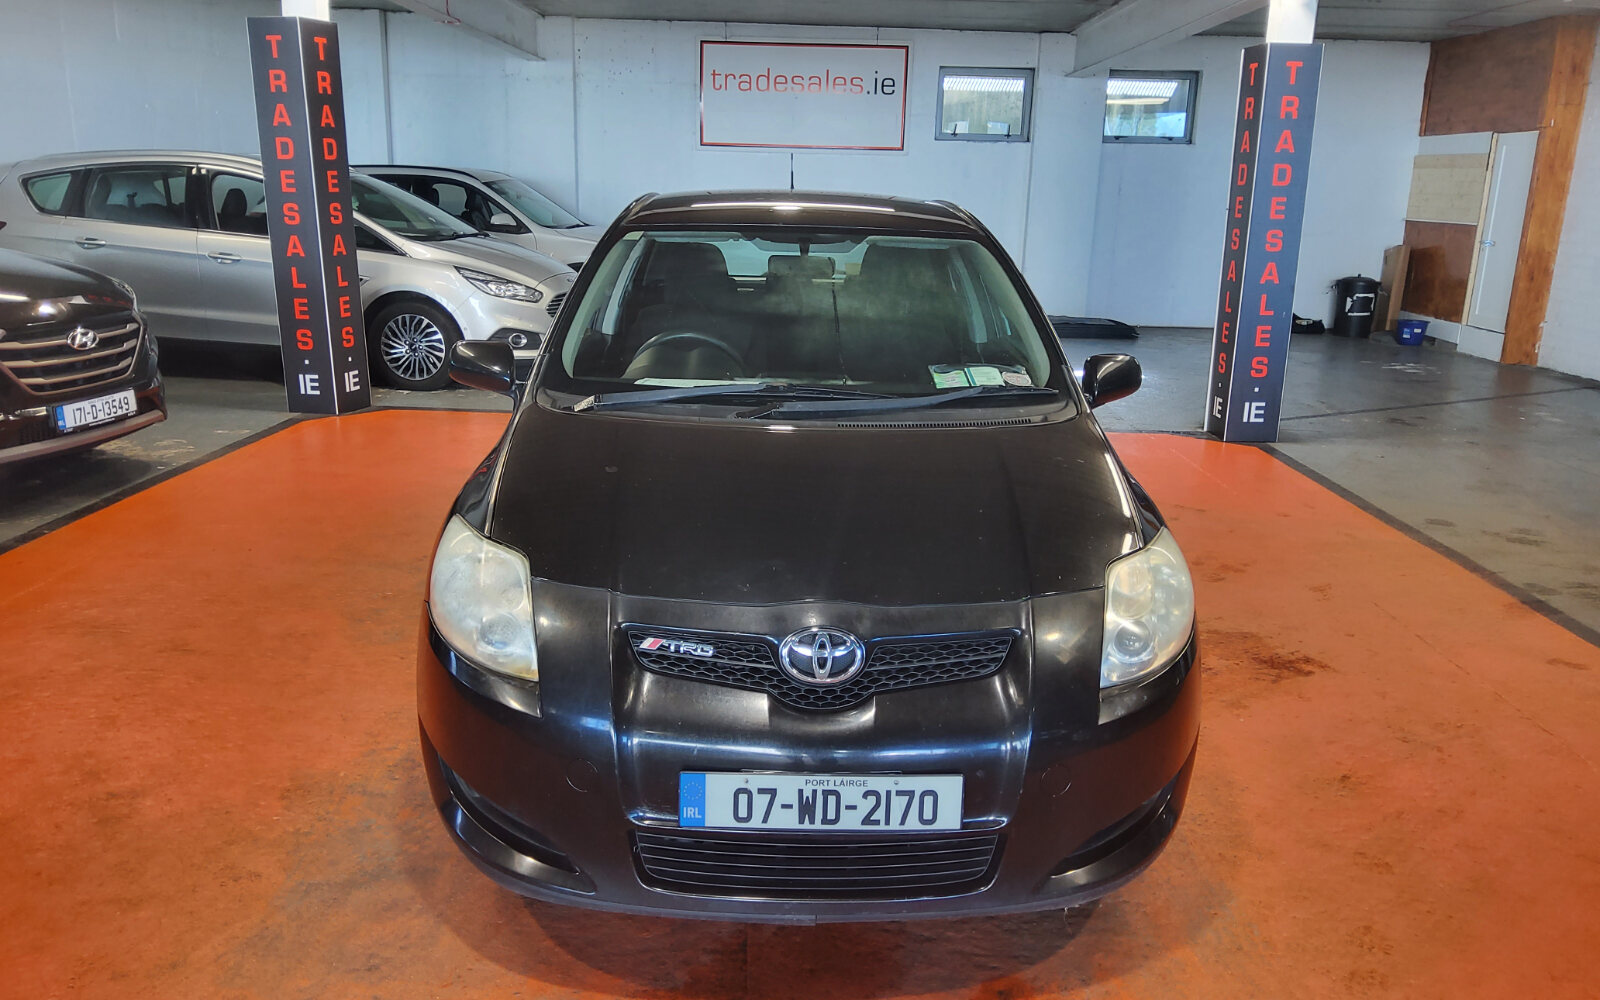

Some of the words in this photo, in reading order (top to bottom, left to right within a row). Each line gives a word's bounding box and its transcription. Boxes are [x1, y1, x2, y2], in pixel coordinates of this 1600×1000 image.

[711, 67, 896, 96] tradesales.ie
[72, 396, 130, 424] 171-D-13549
[805, 779, 831, 787] PORT
[833, 778, 869, 788] LÁIRGE
[683, 806, 702, 819] IRL
[732, 788, 939, 826] 07-WD-2170
